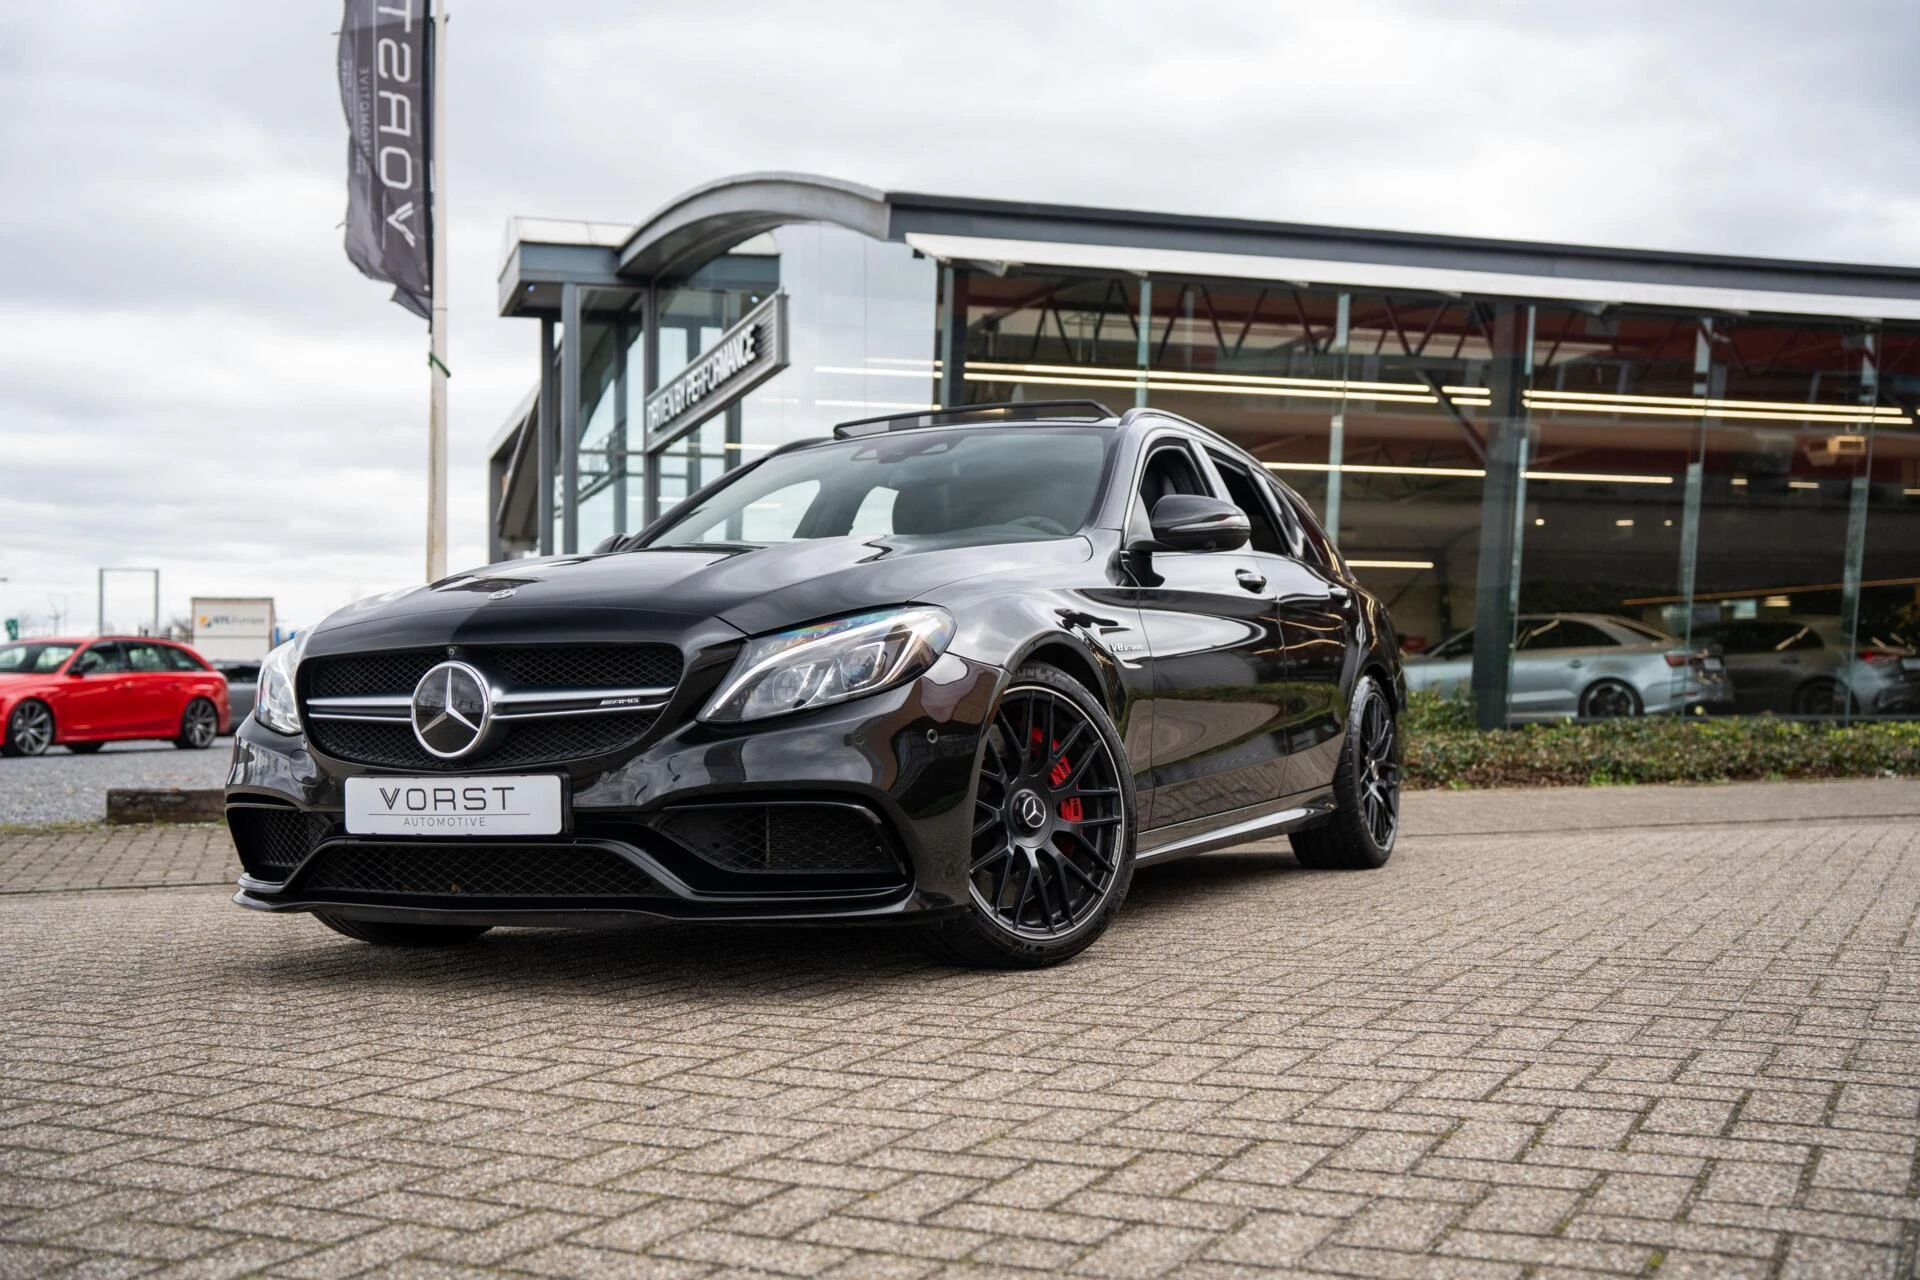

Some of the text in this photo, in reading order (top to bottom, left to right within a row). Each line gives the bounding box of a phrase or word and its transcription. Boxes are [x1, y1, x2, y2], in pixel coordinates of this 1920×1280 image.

[1109, 643, 1123, 652] V8
[379, 787, 515, 811] VORST
[403, 816, 486, 827] AUTOMOTIVE
